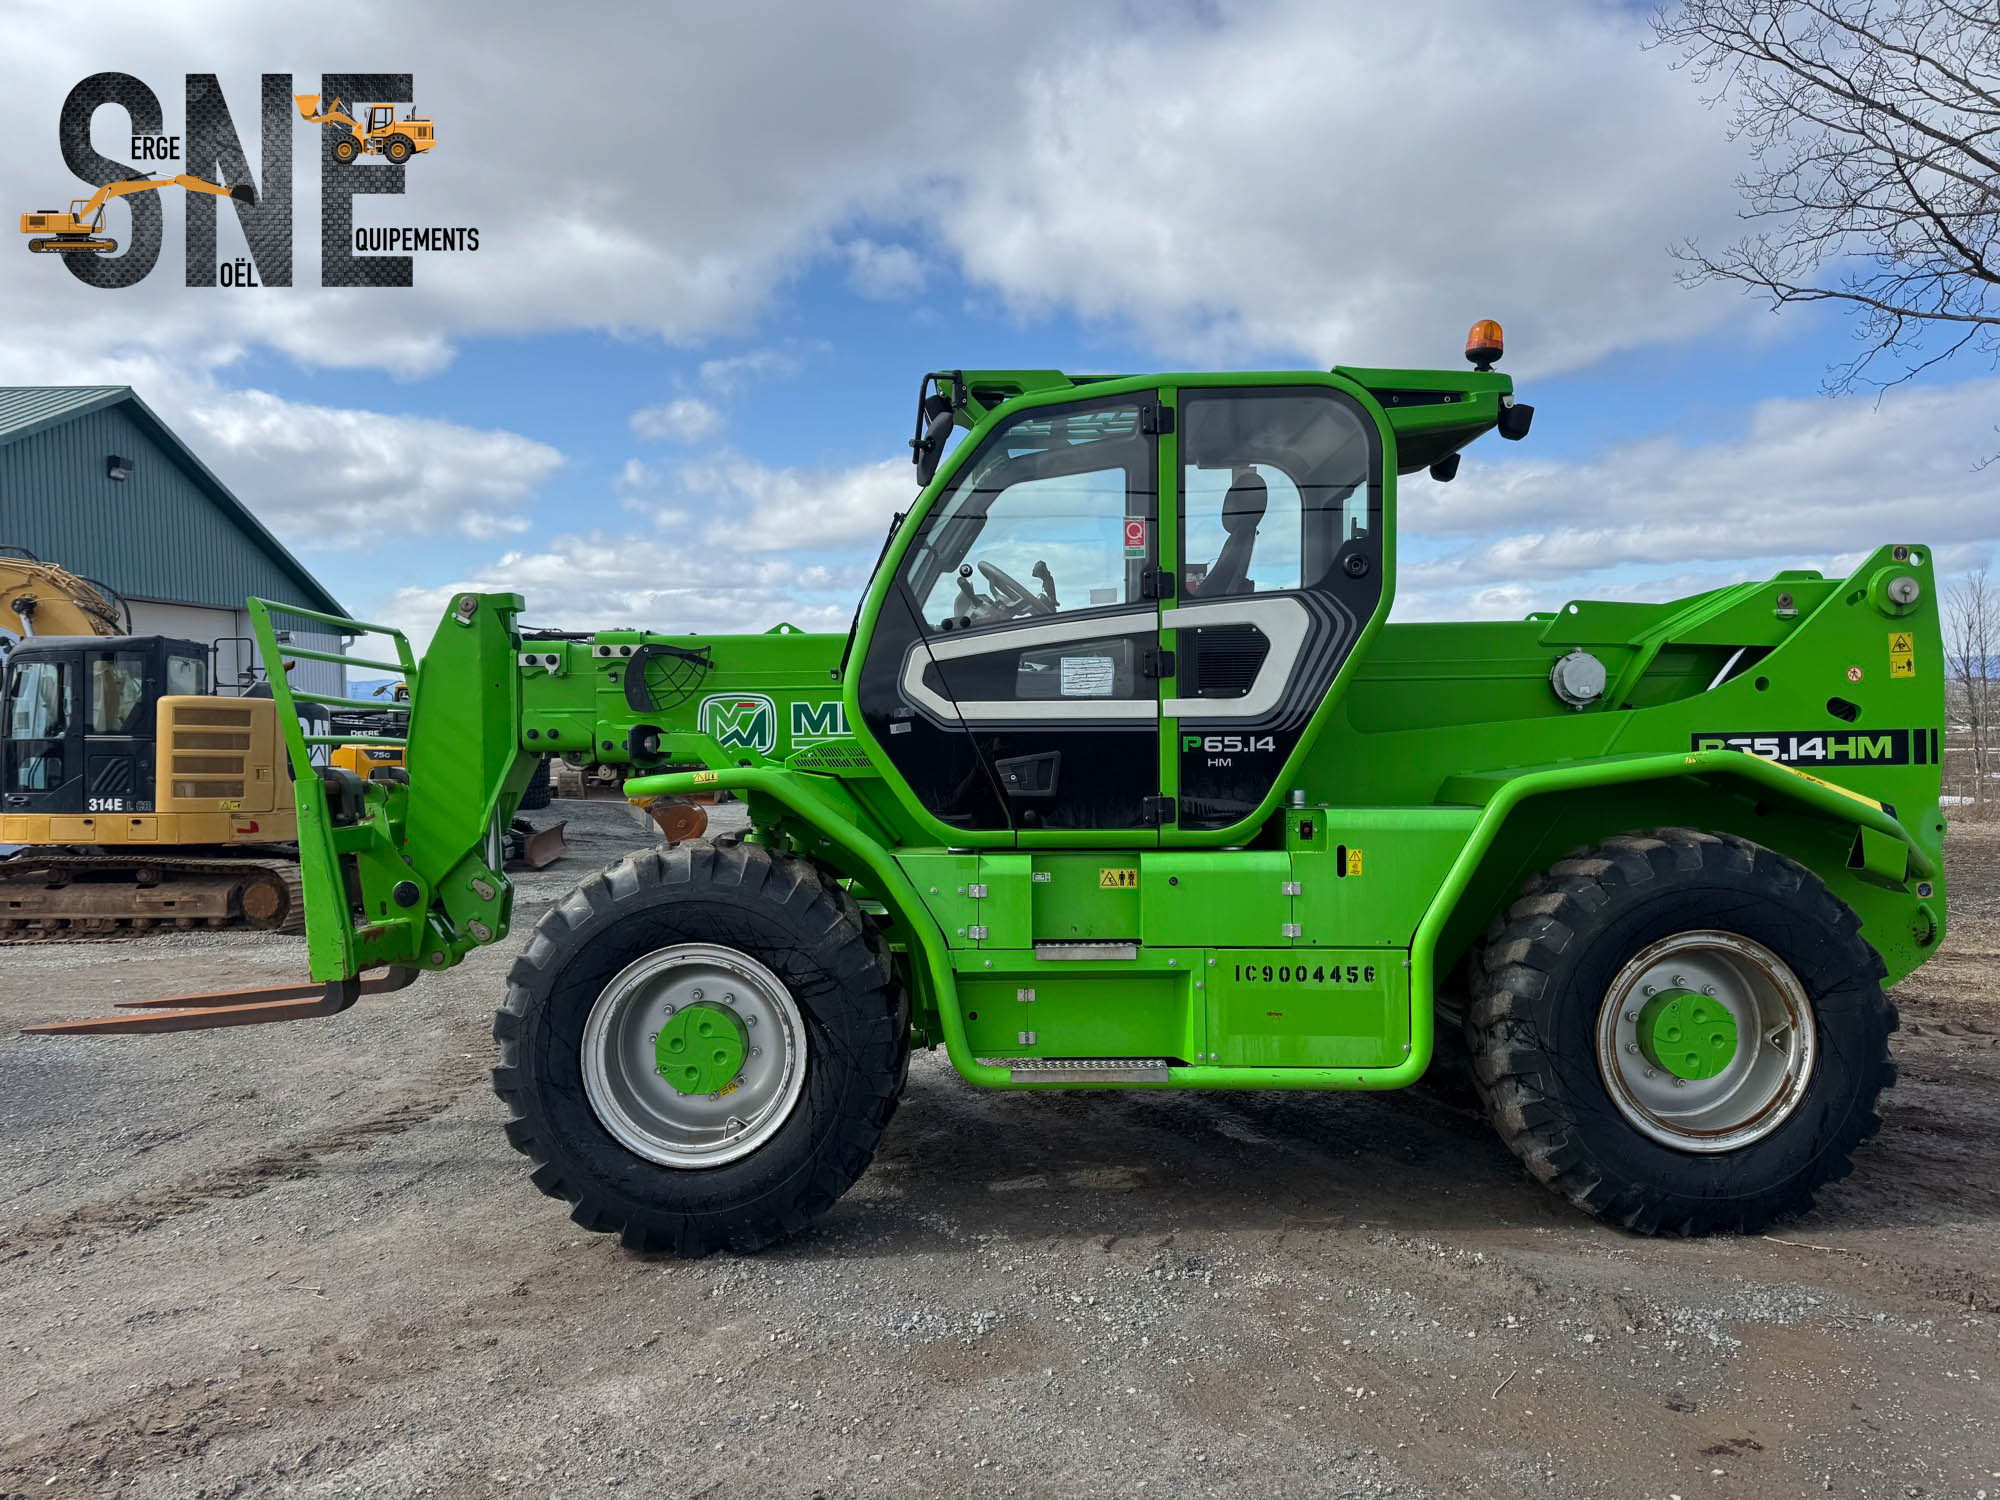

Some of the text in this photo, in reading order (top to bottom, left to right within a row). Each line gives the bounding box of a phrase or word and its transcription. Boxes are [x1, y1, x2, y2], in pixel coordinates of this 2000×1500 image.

[350, 729, 380, 737] DEERE
[1183, 736, 1276, 753] P65.14
[1207, 758, 1232, 767] HM
[88, 797, 123, 812] 314E
